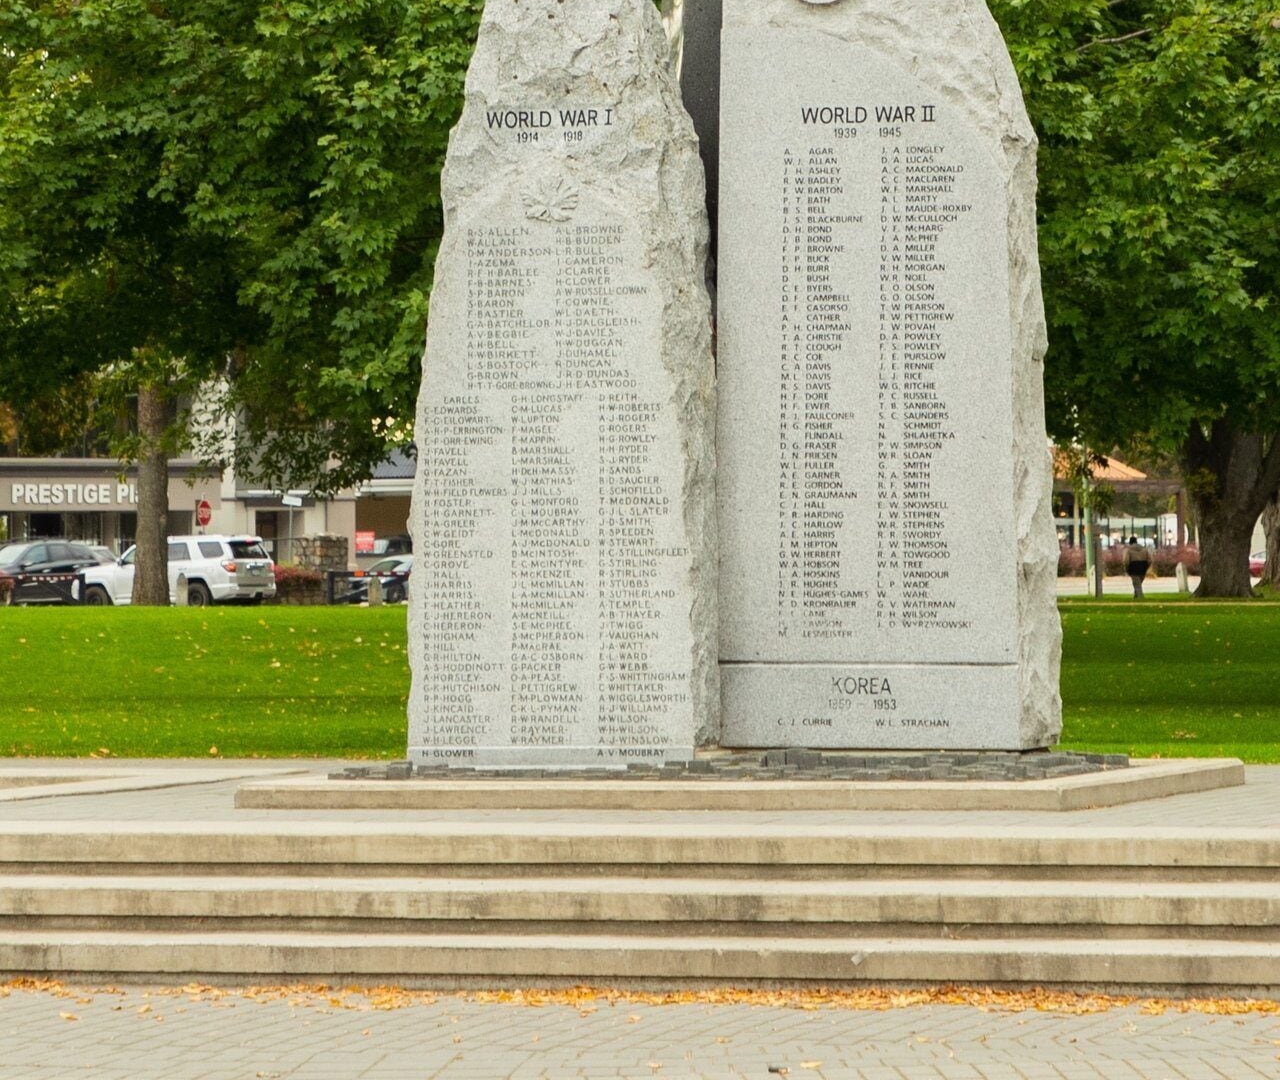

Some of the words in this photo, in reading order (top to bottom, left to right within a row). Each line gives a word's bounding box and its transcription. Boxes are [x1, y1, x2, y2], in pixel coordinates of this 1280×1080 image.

[801, 106, 867, 124] WORLD
[875, 105, 915, 123] WAR
[921, 105, 936, 122] II
[486, 111, 552, 129] WORLD
[559, 110, 598, 127] WAR
[604, 109, 613, 126] I
[517, 132, 539, 143] 1914
[563, 130, 583, 142] 1918
[834, 127, 857, 138] 1939
[879, 127, 901, 137] 1945
[808, 147, 834, 155] AGAR
[905, 146, 945, 154] LONGLEY
[905, 155, 934, 163] LUCAS
[808, 166, 841, 175] ASHLEY
[905, 165, 964, 173] MACDONALD
[807, 176, 842, 184] BADLEY
[905, 175, 955, 183] MACLAREN
[807, 186, 844, 194] BARTON
[905, 185, 953, 193] MARSHALL
[807, 196, 831, 204] BATH
[905, 194, 938, 203] MARTY
[807, 205, 827, 214] BELL
[807, 215, 864, 223] BLACKBURNE
[905, 214, 958, 222] McCULLOCH
[807, 225, 832, 233] BOND
[905, 224, 944, 232] McHARG
[807, 235, 832, 243] BOND
[905, 233, 939, 242] McPHEE
[807, 244, 846, 253] BROWNE
[905, 243, 935, 252] MILLER
[806, 254, 830, 263] BUCK
[904, 253, 935, 261] MILLER
[806, 264, 830, 272] BURR
[904, 263, 946, 271] MORGAN
[806, 274, 830, 282] BUSH
[904, 273, 927, 281] NOEL
[806, 284, 833, 292] BYERS
[904, 283, 935, 291] OLSON
[806, 293, 851, 302] CAMPBELL
[904, 292, 935, 301] OLSON
[806, 303, 848, 312] CASORSO
[904, 302, 945, 311] PEARSON
[806, 313, 841, 321] CATHER
[904, 312, 955, 320] PETTIGREW
[806, 323, 852, 331] CHAPMAN
[904, 322, 936, 330] POVAH
[806, 333, 844, 341] CHRISTIE
[904, 332, 941, 340] POWLEY
[806, 343, 842, 351] CLOUGH
[904, 342, 941, 350] POWLEY
[805, 352, 823, 361] COE
[904, 352, 947, 360] PURSLOW
[805, 362, 832, 371] DAVIS
[904, 361, 934, 370] RENNIE
[805, 372, 831, 380] DAVIS
[904, 371, 923, 380] RICE
[805, 382, 831, 390] DAVIS
[903, 381, 936, 390] RITCHIE
[805, 392, 829, 400] DORE
[903, 391, 938, 400] RUSSELL
[805, 402, 830, 410] EWER
[903, 401, 946, 409] SANBORN
[805, 412, 855, 420] FAULCONER
[903, 411, 949, 419] SAUNDERS
[804, 421, 833, 430] FISHER
[903, 421, 942, 429] SCHMIDT
[903, 431, 955, 439] SHLAHETKA
[804, 441, 837, 449] FRASER
[903, 441, 943, 449] SIMPSON
[804, 451, 838, 459] FRIESEN
[903, 451, 933, 459] SLOAN
[804, 461, 835, 469] FULLER
[903, 461, 931, 469] SMITH
[804, 471, 841, 479] GARNER
[903, 470, 931, 479] SMITH
[804, 481, 843, 489] GORDON
[903, 480, 931, 489] SMITH
[11, 483, 111, 504] PRESTIGE
[804, 490, 858, 499] GRAUMANN
[903, 490, 931, 499] SMITH
[803, 500, 825, 509] HALL
[903, 500, 949, 509] SNOWSELL
[198, 507, 211, 516] STOP
[803, 510, 844, 519] HARDING
[902, 510, 940, 519] STEPHEN
[803, 520, 843, 529] HARLOW
[902, 520, 945, 529] STEPHENS
[803, 530, 835, 538] HARRIS
[902, 530, 941, 539] SWORDY
[803, 540, 838, 548] HEPTON
[902, 540, 948, 549] THOMSON
[803, 550, 841, 558] HERBERT
[902, 550, 951, 558] TOWGOOD
[803, 560, 840, 568] HOBSON
[902, 560, 923, 568] TREE
[803, 570, 841, 578] HOSKINS
[902, 570, 950, 578] VANIDOUR
[803, 580, 838, 588] HUGHES
[902, 580, 930, 588] WADE
[902, 590, 929, 598] WAHL
[902, 600, 956, 608] WATERMAN
[902, 610, 938, 618] WILSON
[831, 676, 892, 695] KOREA
[873, 698, 897, 710] 1953
[802, 718, 832, 727] CURRIE
[901, 719, 950, 727] STRACHAN
